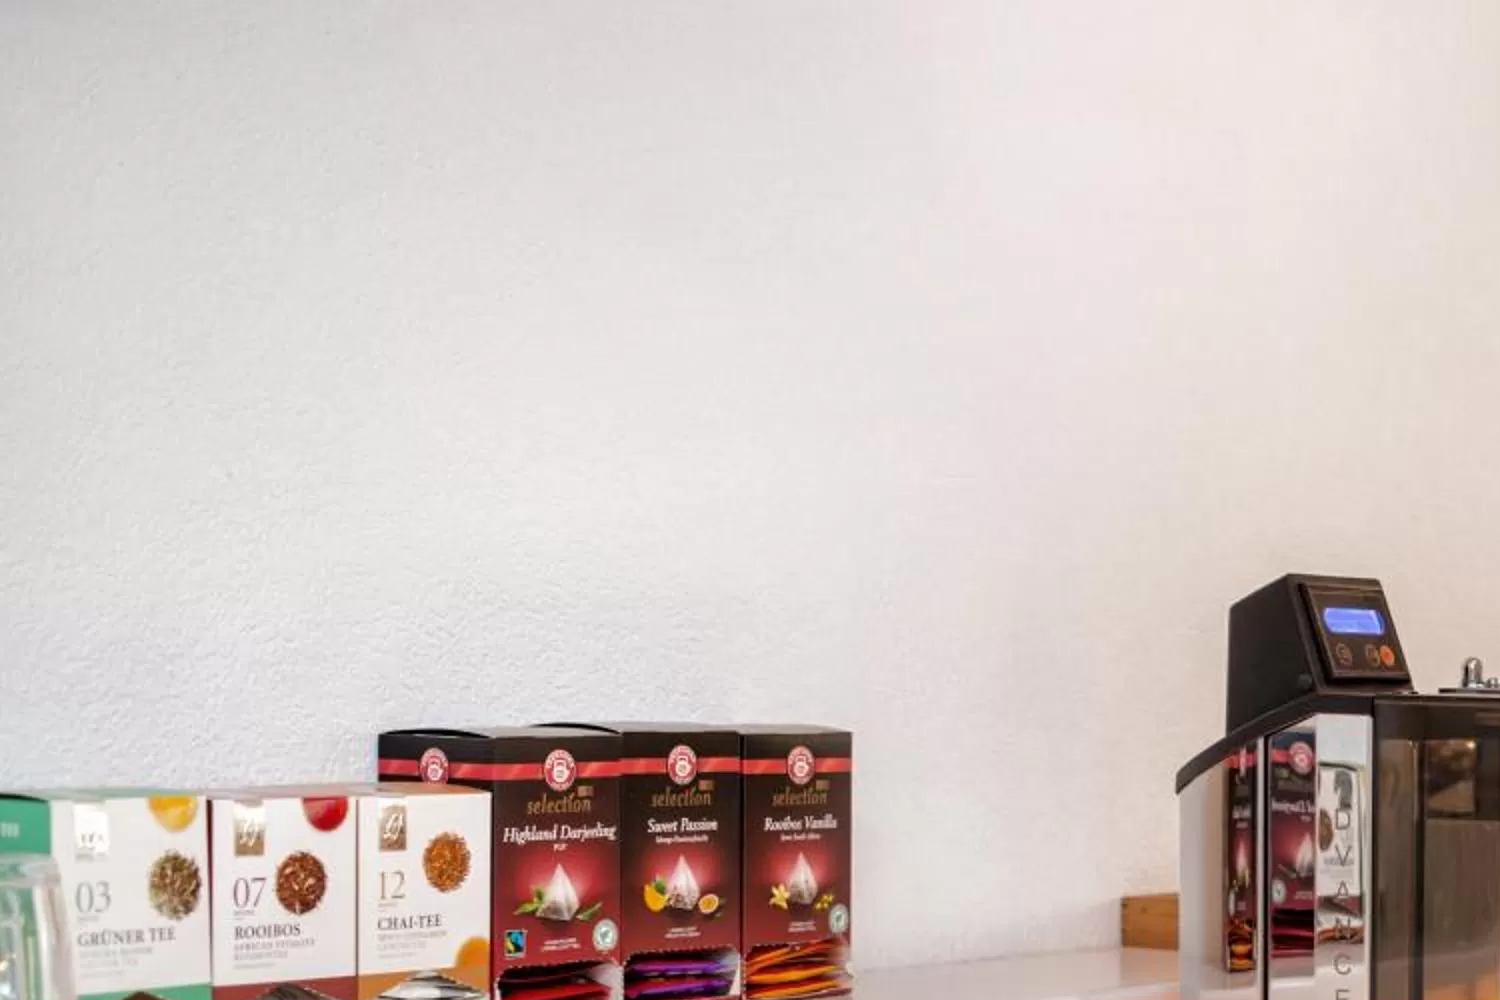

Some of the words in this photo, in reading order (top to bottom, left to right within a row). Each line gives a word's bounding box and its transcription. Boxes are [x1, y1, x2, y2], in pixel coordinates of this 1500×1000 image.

[527, 792, 591, 814] selection
[503, 823, 559, 846] Highland
[560, 821, 617, 843] Darjeeling
[233, 877, 267, 909] 07
[379, 869, 405, 900] 12
[75, 880, 111, 913] 03
[234, 923, 301, 940] ROOIBOS
[377, 914, 443, 930] CHAI-TEE
[77, 928, 146, 946] GRÜNER
[148, 927, 176, 943] TEE
